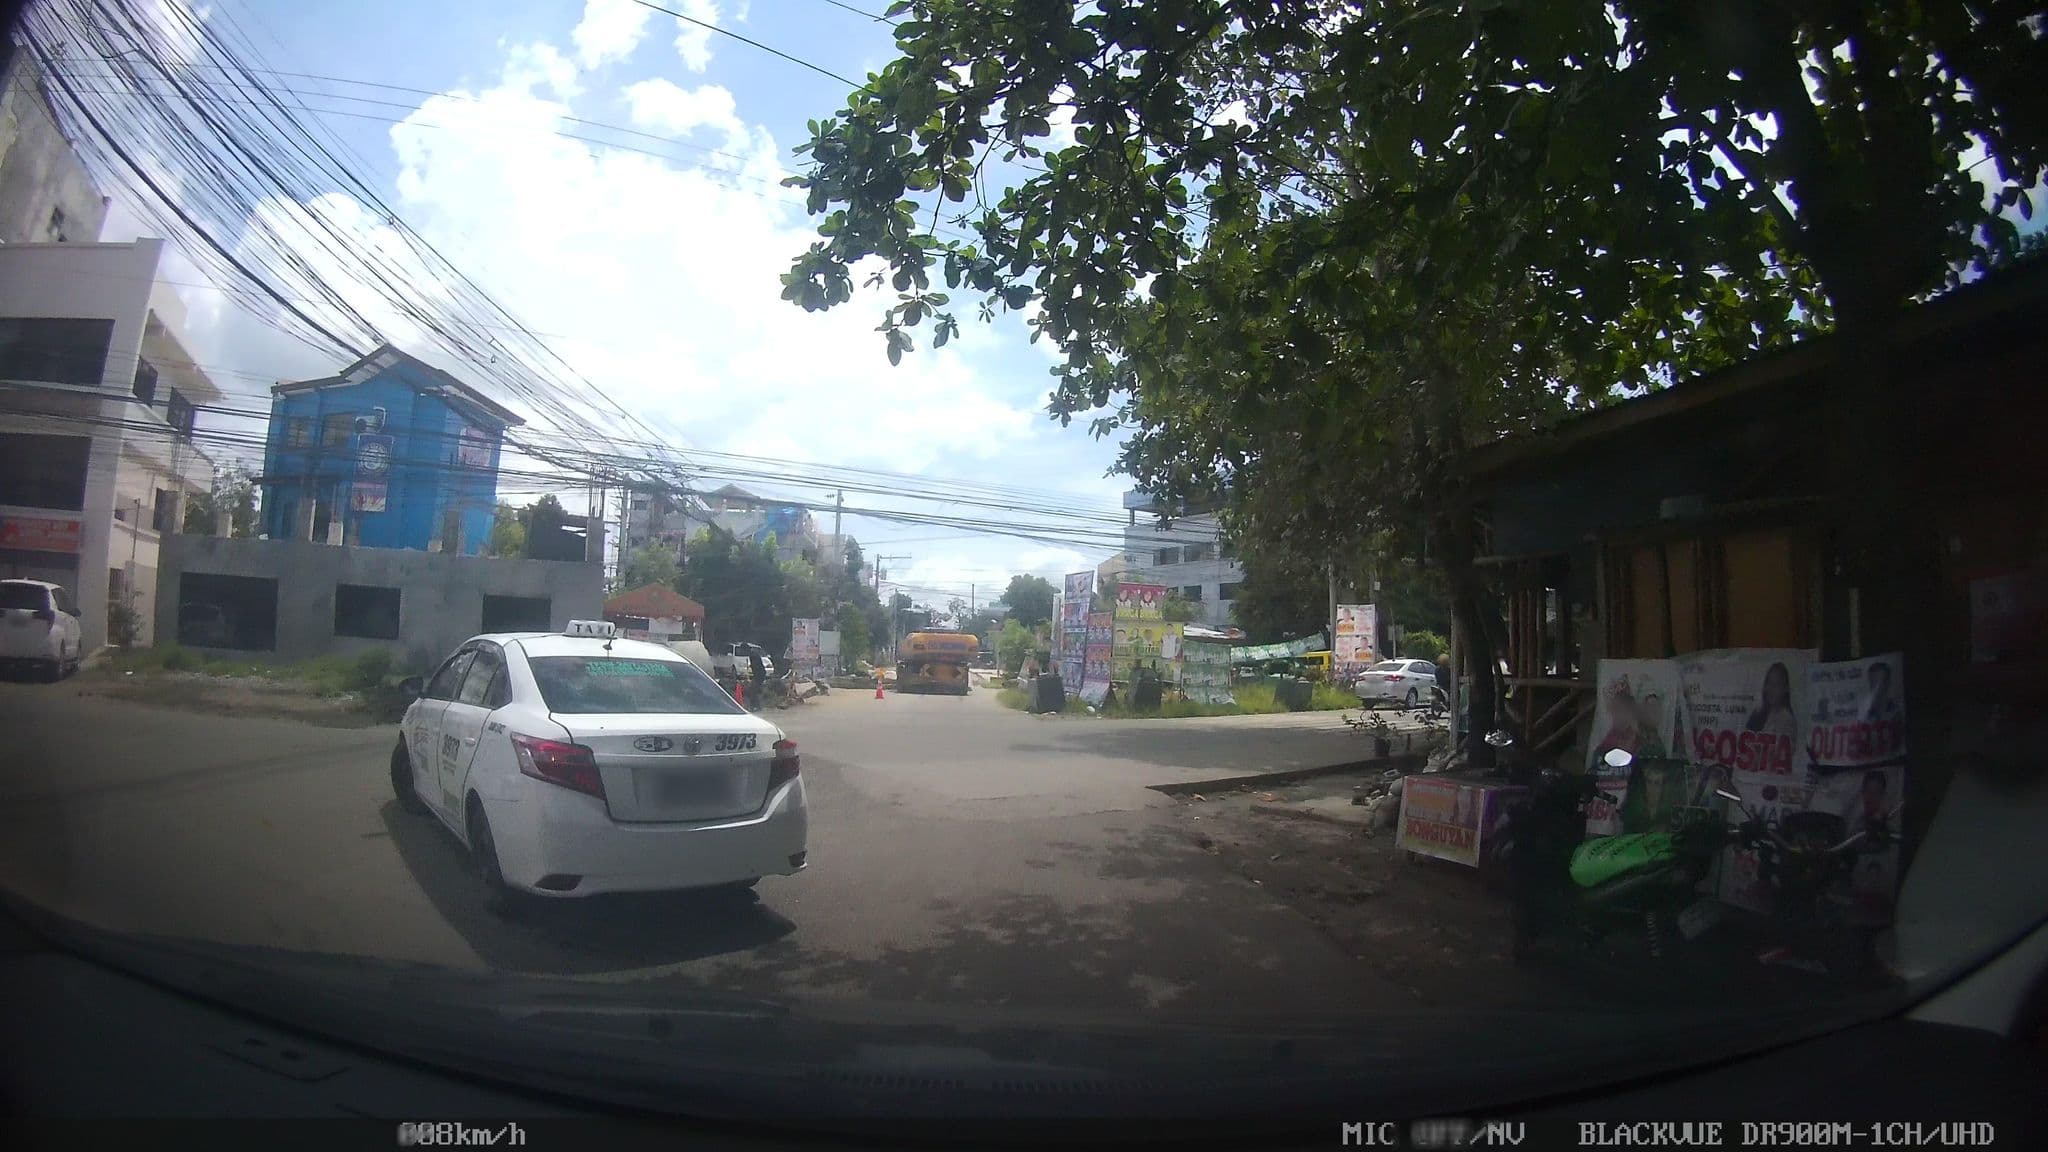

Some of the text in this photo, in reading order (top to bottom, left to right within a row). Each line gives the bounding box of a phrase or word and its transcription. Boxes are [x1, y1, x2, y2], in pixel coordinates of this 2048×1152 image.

[574, 622, 616, 636] TAXI
[714, 732, 757, 752] 3973
[1811, 720, 1904, 759] UTER
